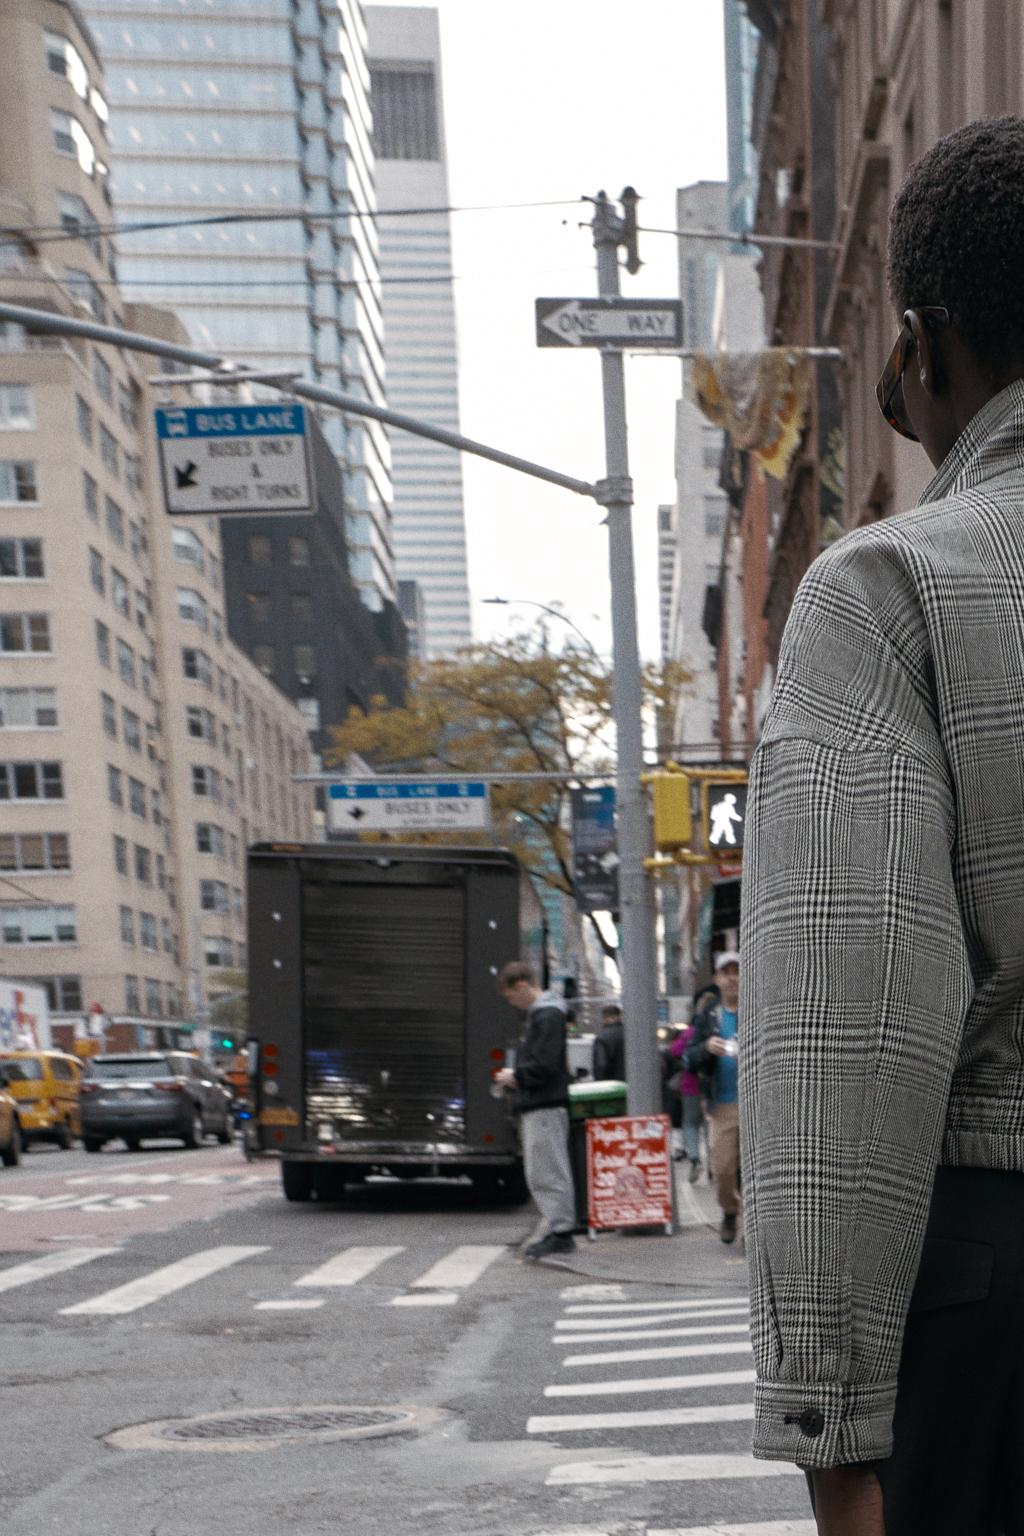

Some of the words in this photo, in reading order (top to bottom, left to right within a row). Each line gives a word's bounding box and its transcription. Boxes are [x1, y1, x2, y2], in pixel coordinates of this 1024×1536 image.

[560, 312, 599, 333] ONE
[627, 314, 668, 331] WAY
[196, 414, 237, 431] BUS
[242, 411, 295, 430] LANE
[208, 440, 253, 457] BUSES
[260, 440, 294, 456] ONLY
[210, 485, 249, 501] RIGHT
[256, 483, 300, 499] TURNS
[385, 802, 431, 815] BUSES
[437, 801, 470, 814] ONLY
